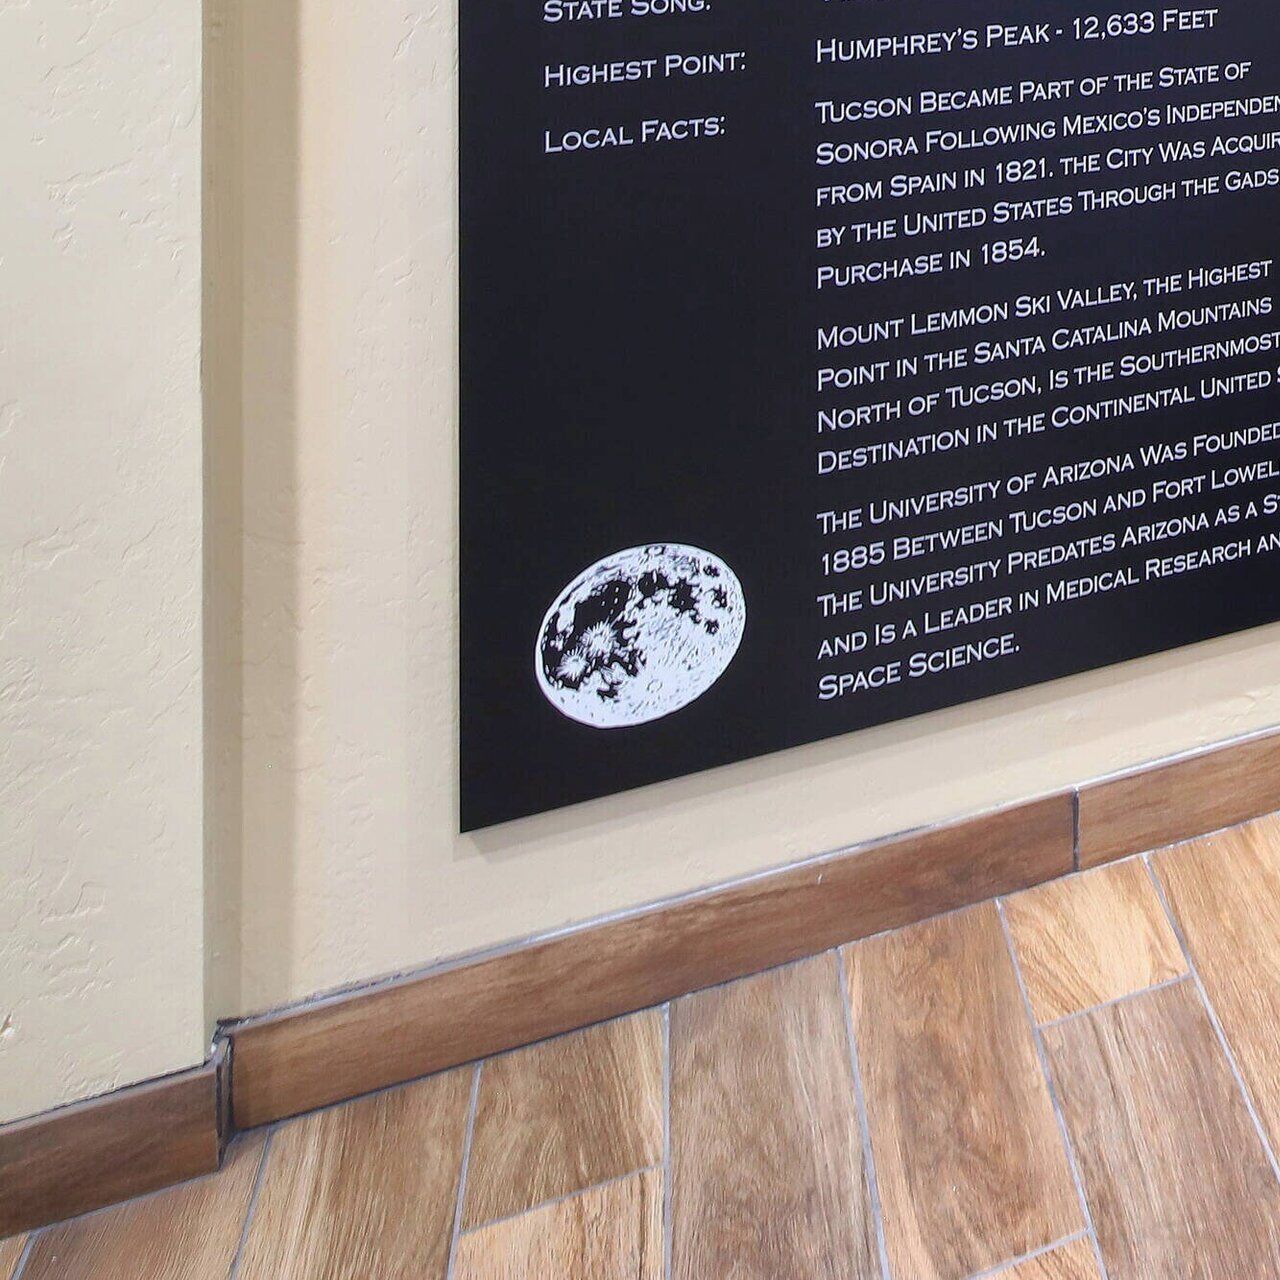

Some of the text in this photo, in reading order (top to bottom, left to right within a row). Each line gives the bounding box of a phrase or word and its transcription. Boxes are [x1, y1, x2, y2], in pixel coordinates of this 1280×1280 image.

[986, 23, 1051, 48] PEAK
[1073, 11, 1156, 41] 12,633
[1162, 8, 1220, 32] FEET
[544, 51, 747, 88] HIGHEST POINT:
[814, 61, 1253, 124] TUCSON BECAME PART OF THE STATE OF
[545, 116, 726, 154] LOCAL FACTS:
[815, 136, 920, 165] SONORA
[925, 120, 1057, 153] FOLLOWING
[816, 180, 884, 207] FROM
[889, 171, 958, 197] SPAIN
[964, 168, 986, 188] IN
[995, 157, 1055, 184] 1821.
[1059, 153, 1102, 176] THE
[1106, 147, 1155, 170] CITY
[1158, 140, 1207, 163] WAS
[816, 225, 847, 248] BY
[850, 219, 898, 243] THE
[903, 207, 988, 236] UNITED
[992, 196, 1074, 224] STATES
[1077, 181, 1177, 212] THROUGH
[1180, 175, 1221, 197] THE
[817, 236, 1047, 290] PURCHASE IN 1854.
[816, 508, 864, 535] THE
[869, 479, 1002, 524] UNIVERSITY
[1006, 472, 1038, 495] OF
[1042, 453, 1136, 489] ARIZONA
[1139, 441, 1189, 467] WAS
[816, 590, 864, 618] THE
[870, 558, 1003, 606] UNIVERSITY
[1007, 533, 1117, 575] PREDATES
[1120, 512, 1211, 548] ARIZONA
[1214, 504, 1242, 527] AS
[1244, 501, 1259, 520] A
[817, 631, 869, 660] AND
[875, 623, 897, 646] IS
[901, 619, 919, 640] A
[924, 596, 1014, 634] LEADER
[1019, 589, 1040, 612] IN
[1046, 567, 1141, 605] MEDICAL
[1145, 538, 1252, 581] RESEARCH
[818, 633, 1021, 700] SPACE SCIENCE.
